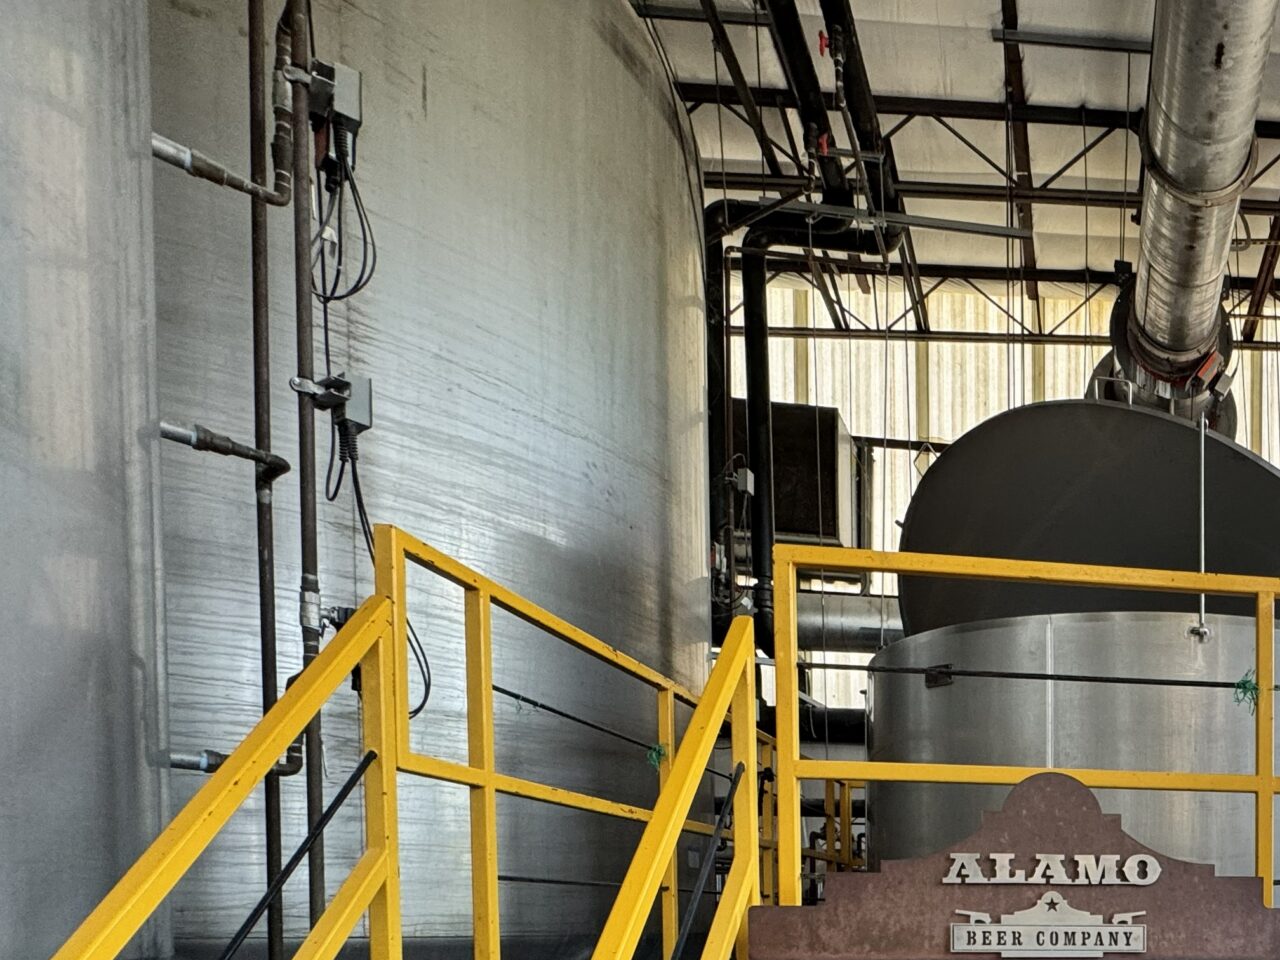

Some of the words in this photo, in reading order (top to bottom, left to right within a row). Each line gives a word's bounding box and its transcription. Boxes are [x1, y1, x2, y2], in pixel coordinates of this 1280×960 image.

[942, 852, 1162, 885] ALAMO
[966, 930, 1023, 946] BEER
[1036, 930, 1133, 947] COMPANY
